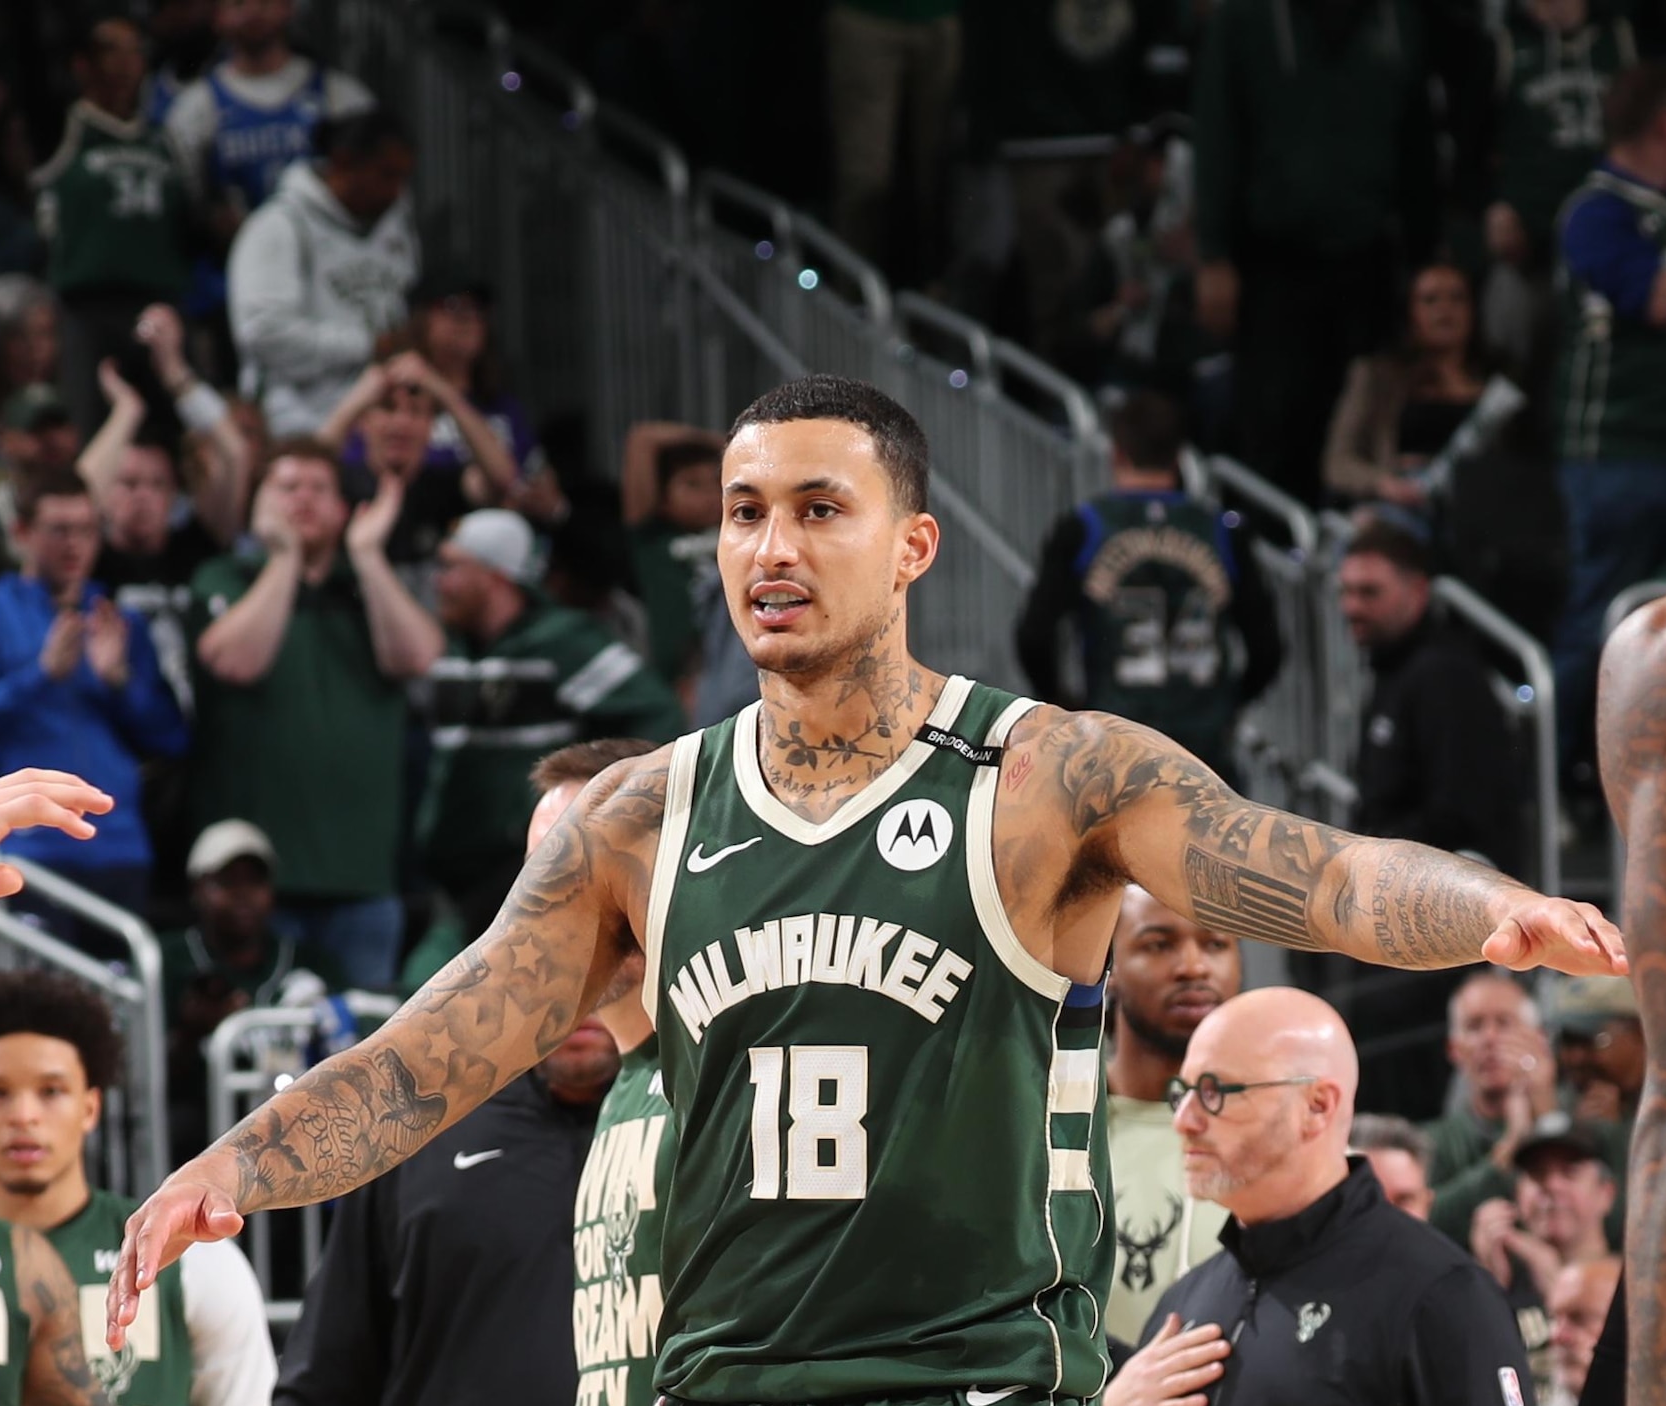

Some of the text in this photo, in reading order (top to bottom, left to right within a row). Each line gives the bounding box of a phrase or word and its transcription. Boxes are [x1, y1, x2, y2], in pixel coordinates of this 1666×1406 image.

[668, 912, 975, 1045] MILWAUKEE
[748, 1045, 869, 1200] 18
[574, 1222, 607, 1282] OR
[573, 1273, 665, 1371] REAM
